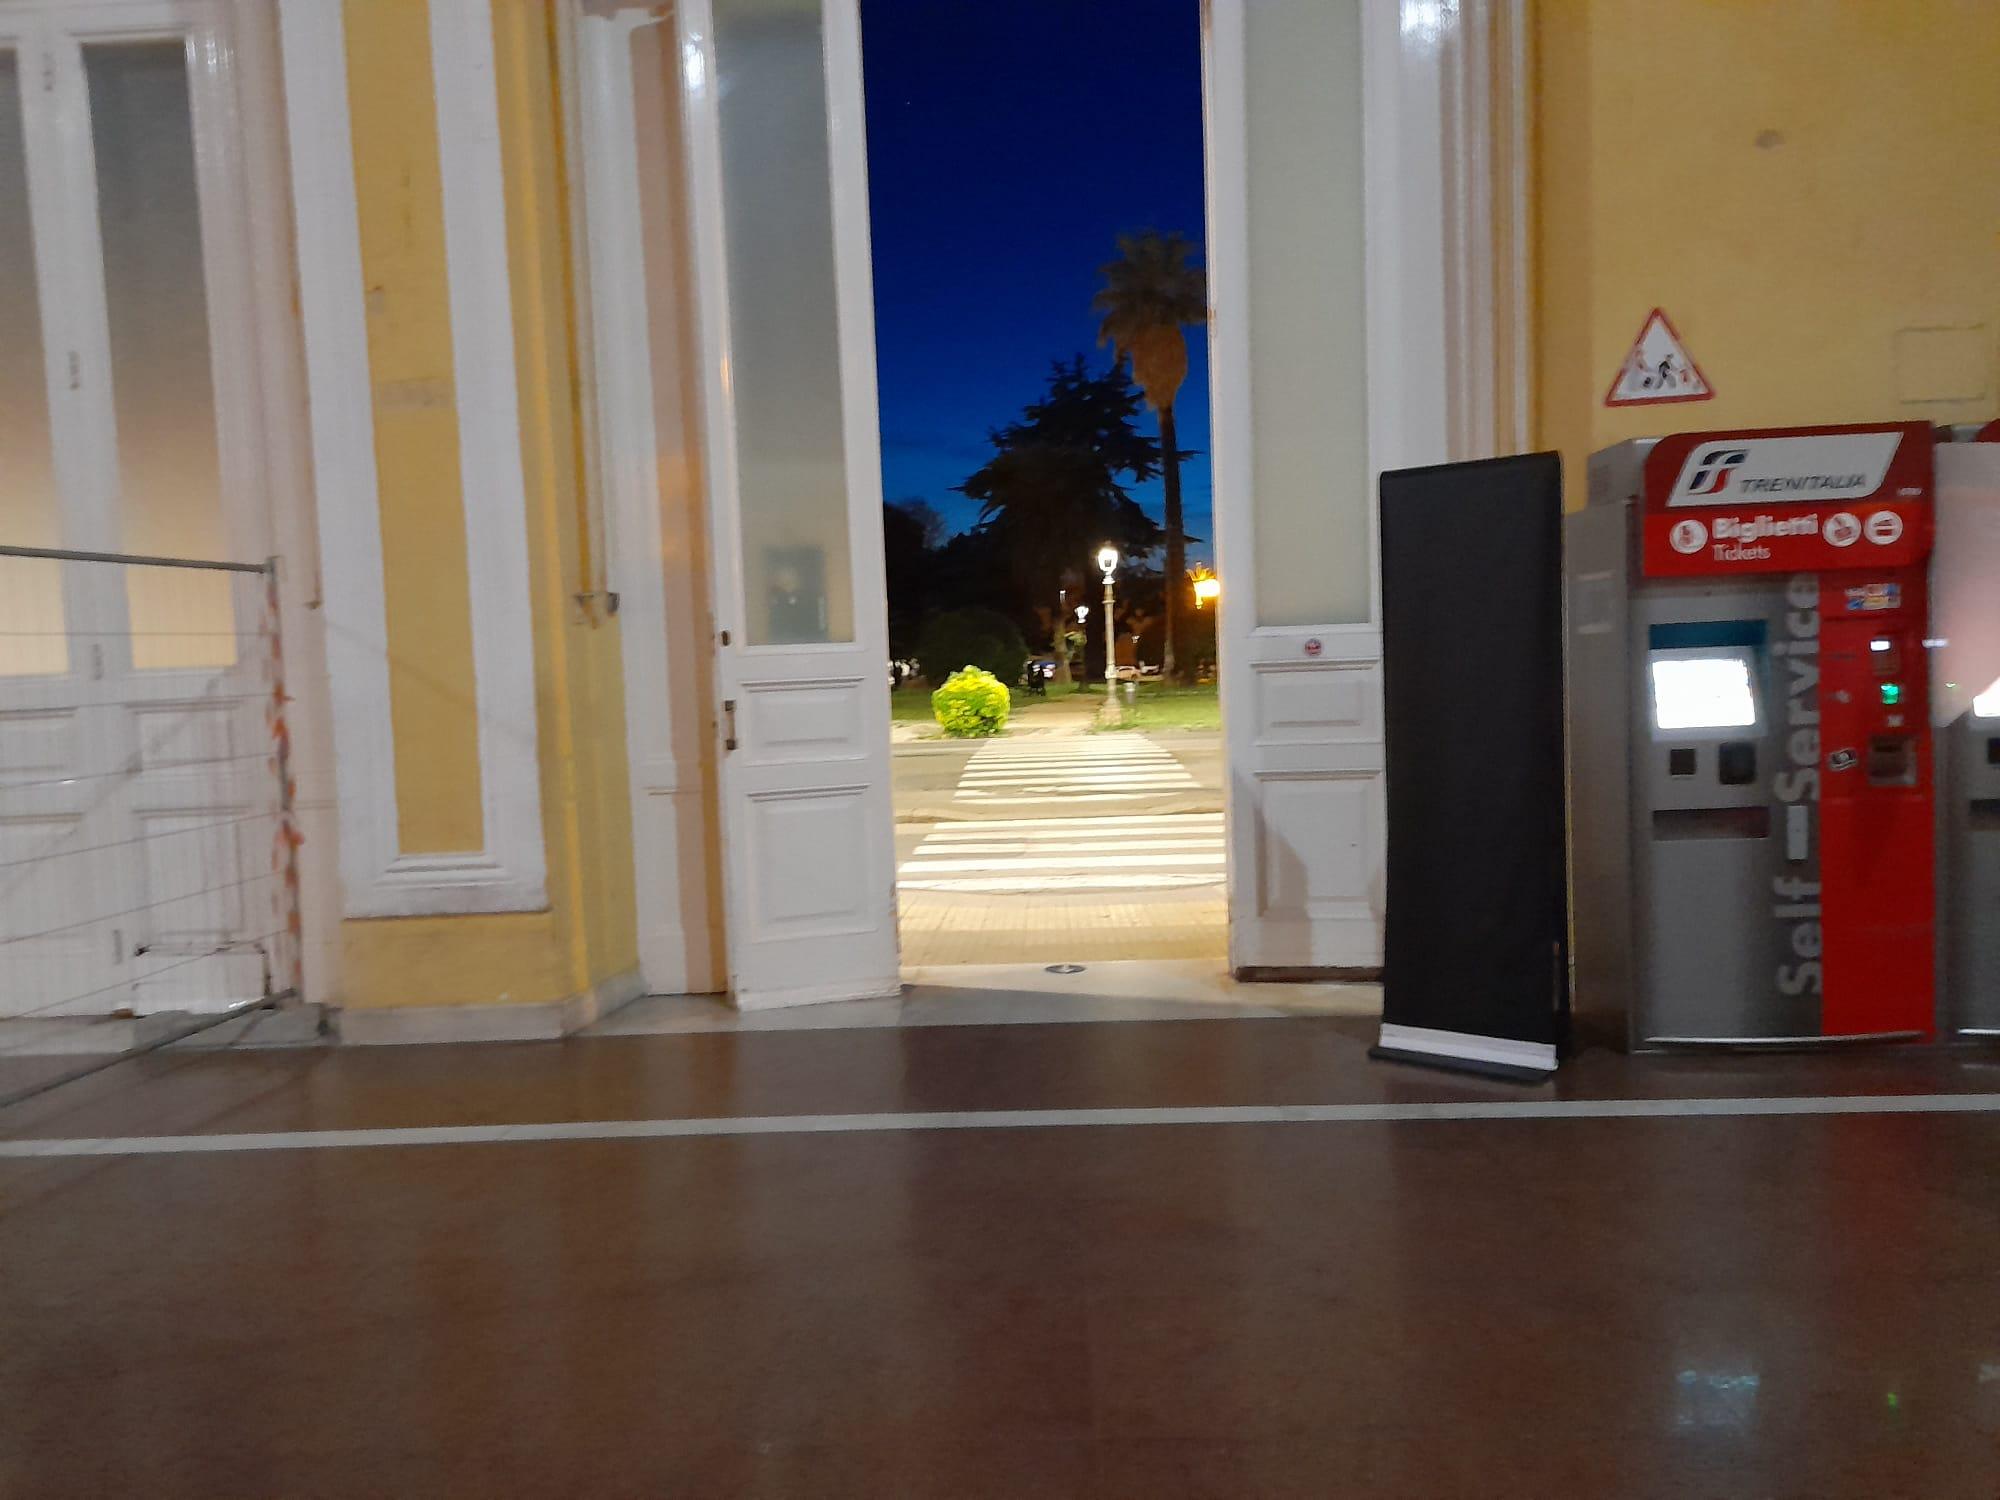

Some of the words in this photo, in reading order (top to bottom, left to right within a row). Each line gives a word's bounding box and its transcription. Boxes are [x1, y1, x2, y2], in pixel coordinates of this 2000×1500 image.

[1741, 472, 1866, 493] TRENITALIA
[1713, 513, 1818, 543] Biglietti
[1713, 544, 1772, 561] Tickets
